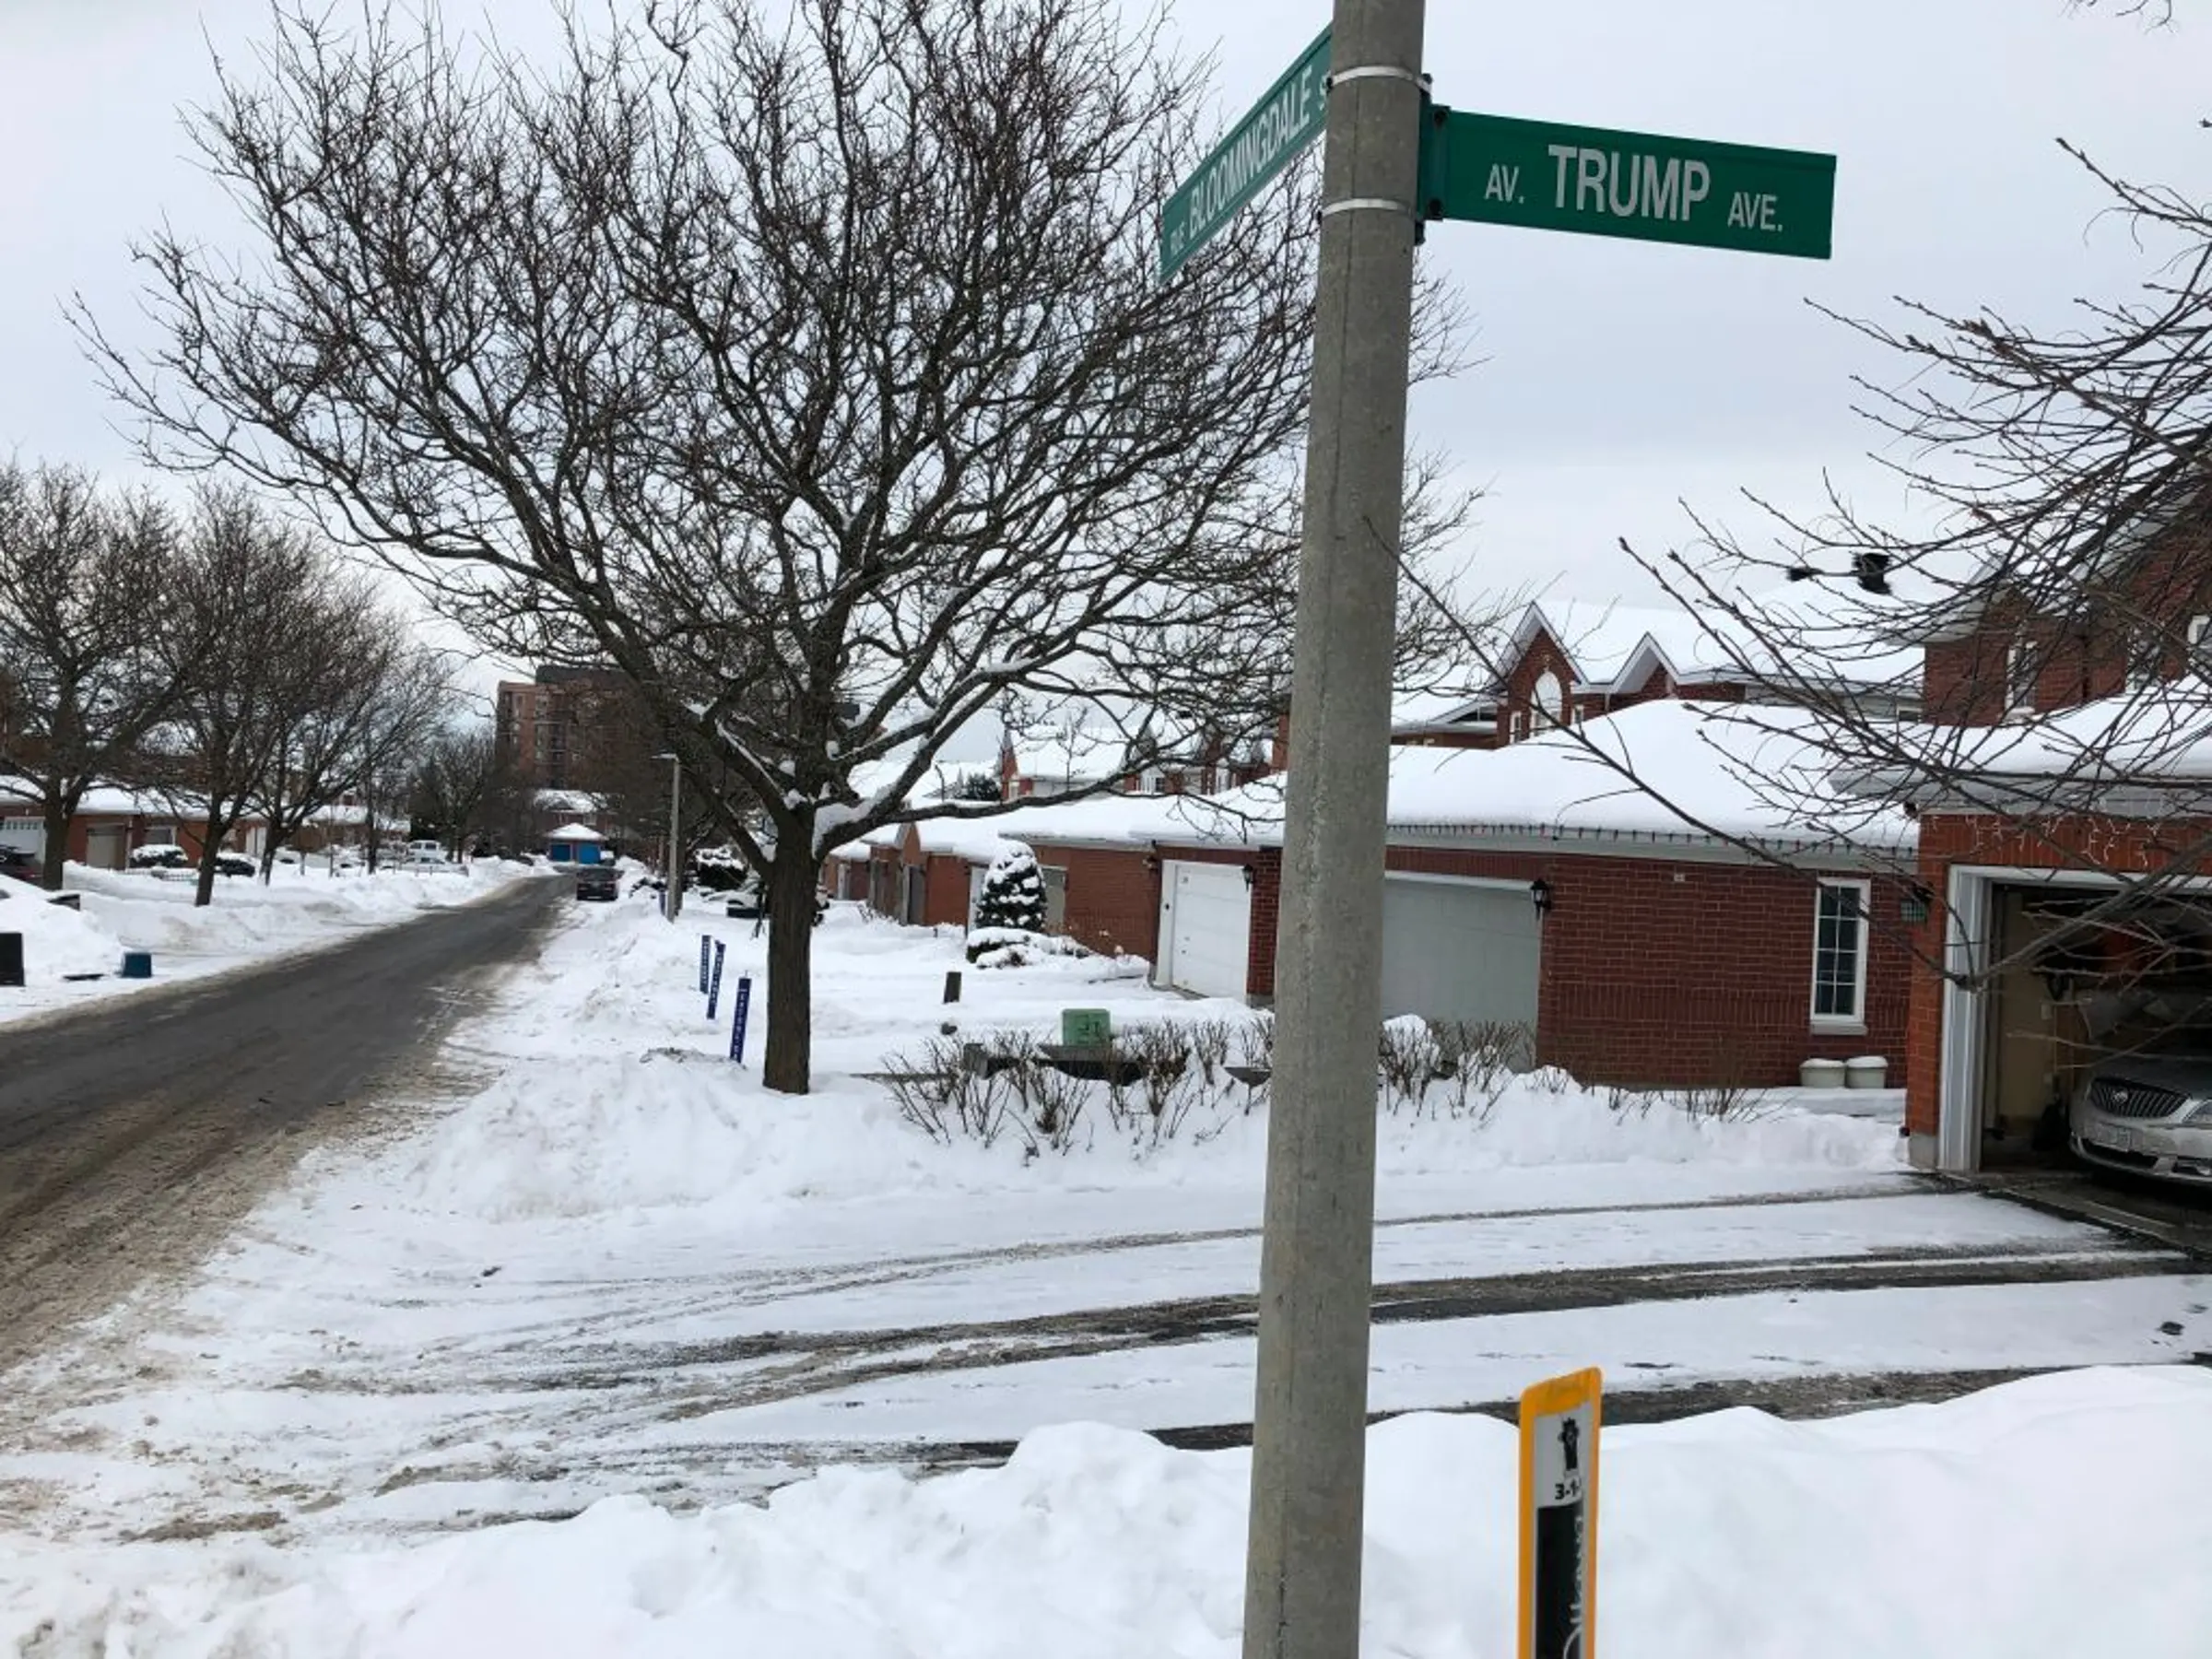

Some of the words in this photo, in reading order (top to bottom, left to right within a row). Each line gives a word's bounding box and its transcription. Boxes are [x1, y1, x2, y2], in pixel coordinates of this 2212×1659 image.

[1189, 65, 1312, 240] BLOOMINGDALE
[1484, 163, 1524, 205] AV.
[1547, 144, 1711, 222] TRUMP
[1727, 191, 1783, 232] AVE.
